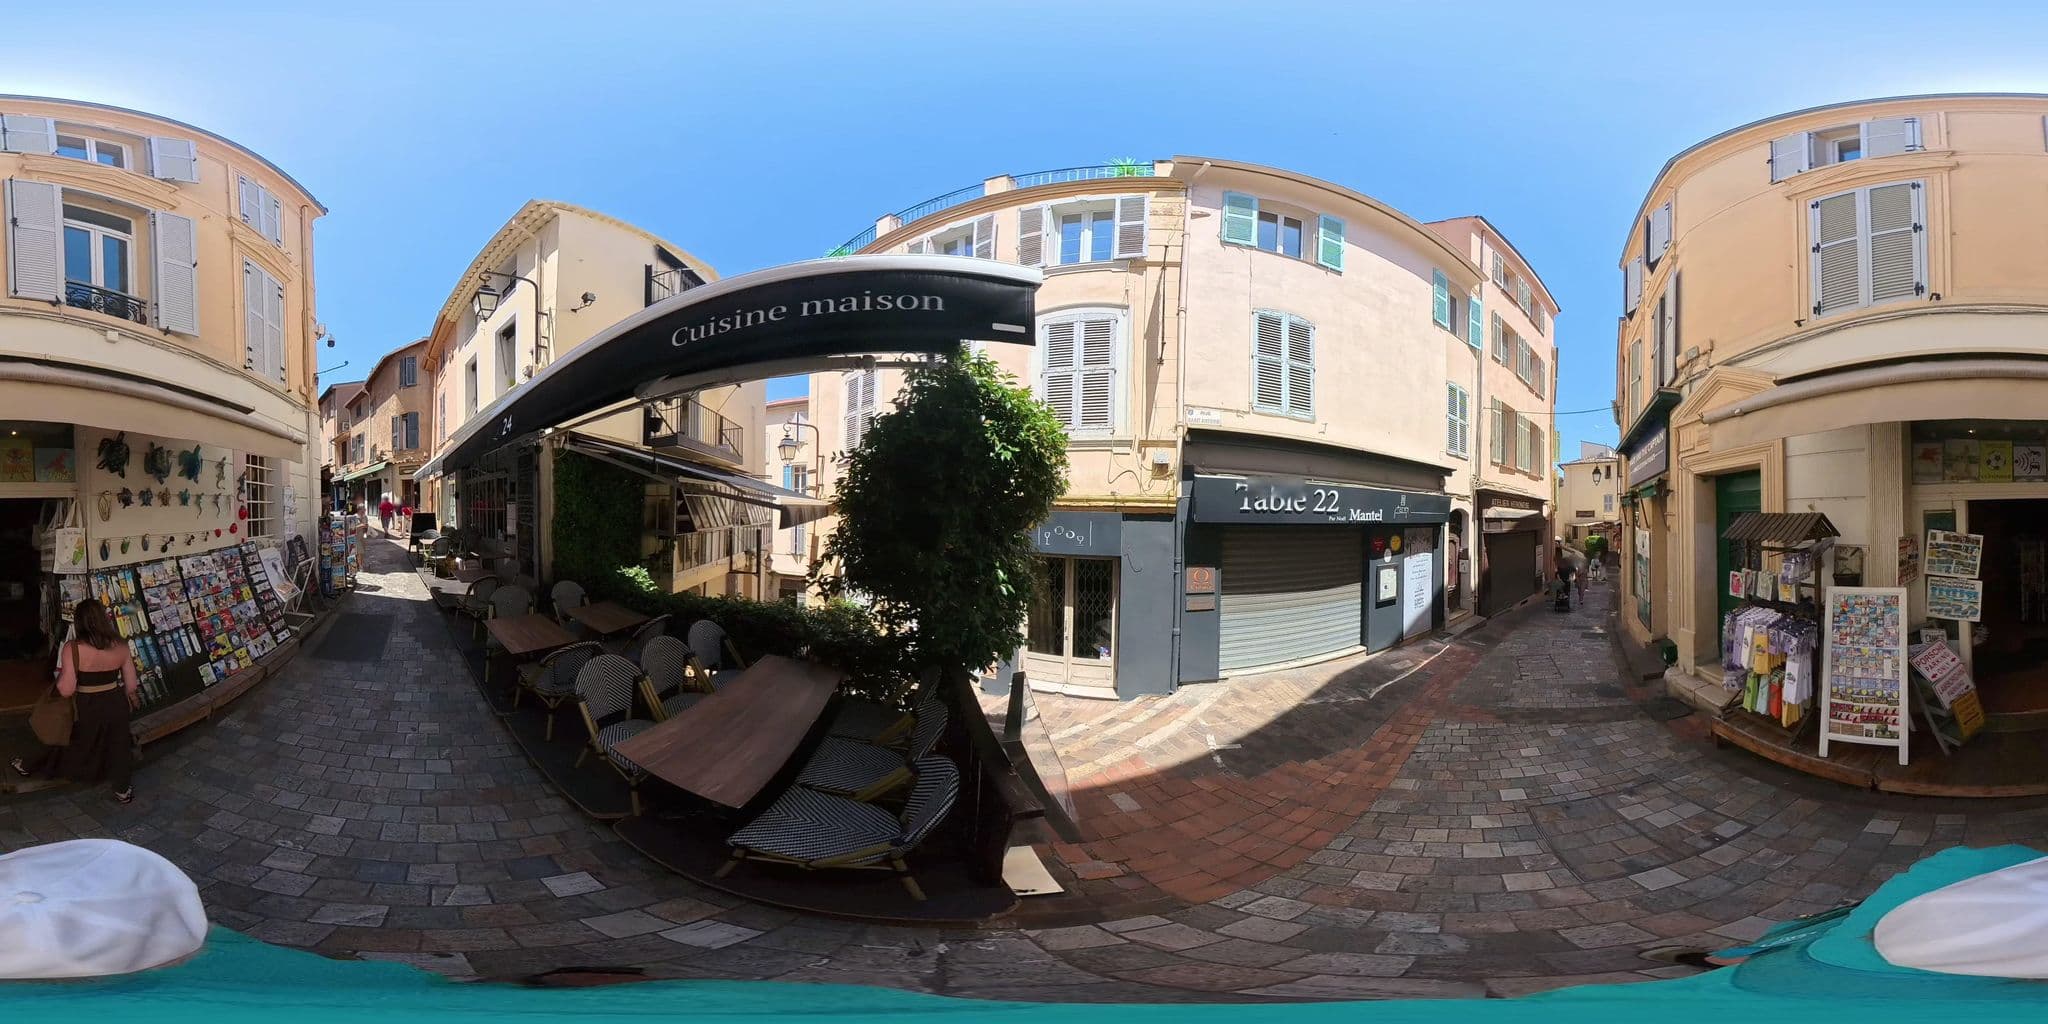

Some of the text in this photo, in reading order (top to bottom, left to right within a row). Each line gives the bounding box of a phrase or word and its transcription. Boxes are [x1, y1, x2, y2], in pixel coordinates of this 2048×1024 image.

[671, 290, 945, 347] Cuisine maison
[502, 414, 512, 436] 24
[1312, 489, 1340, 512] 22
[1349, 508, 1383, 521] Mantel
[1915, 643, 1946, 667] PORSCHE
[1925, 652, 1950, 672] PARKING
